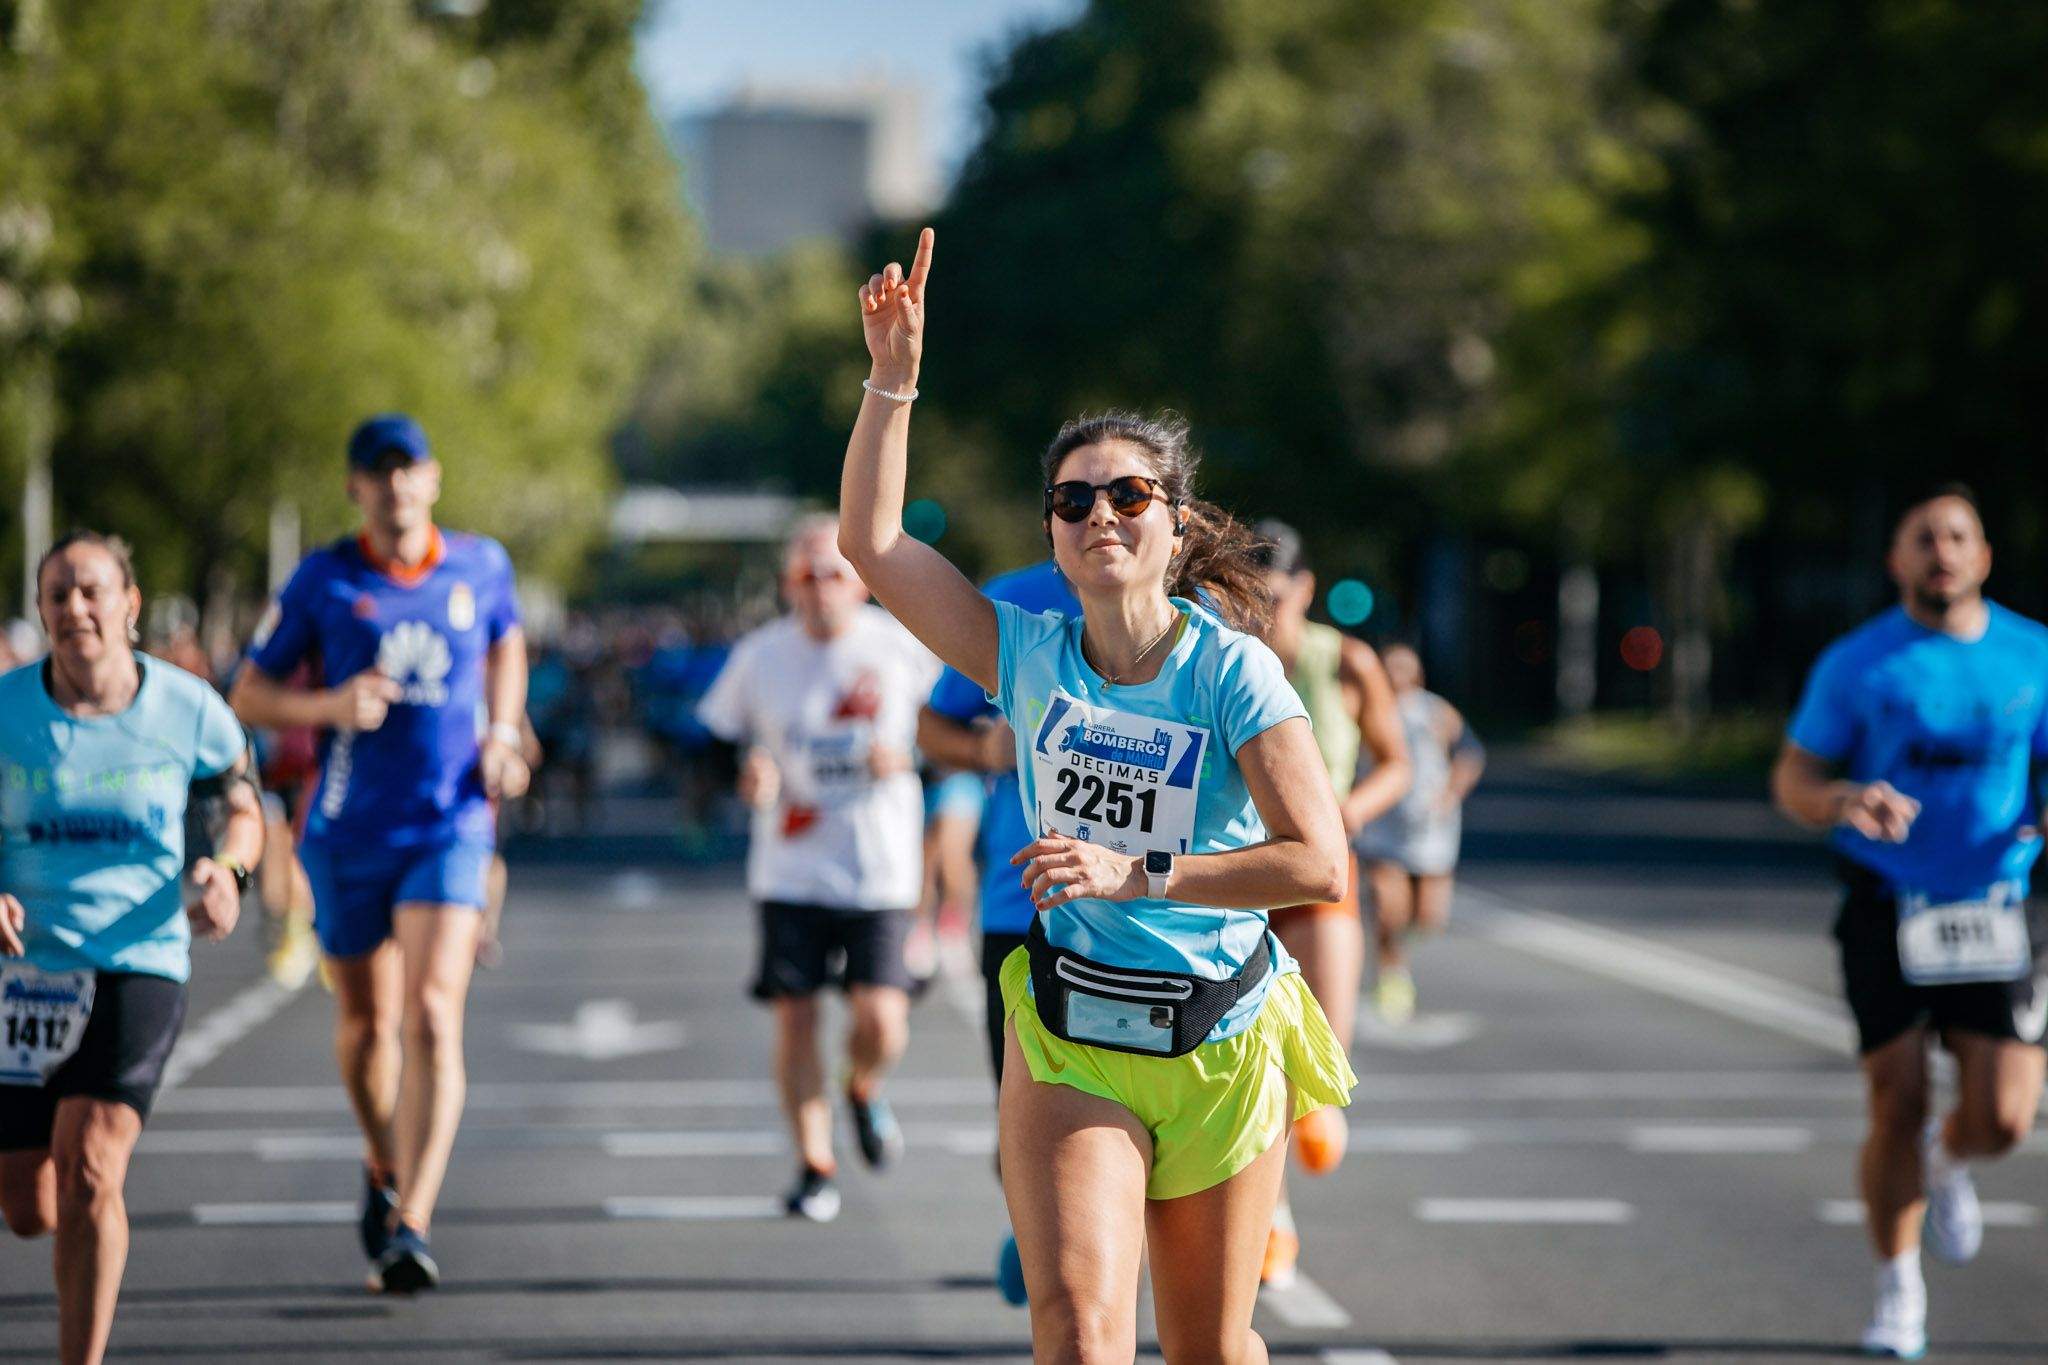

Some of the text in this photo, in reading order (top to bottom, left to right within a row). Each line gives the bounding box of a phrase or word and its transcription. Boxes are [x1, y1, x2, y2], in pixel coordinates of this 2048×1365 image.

[1087, 721, 1116, 734] RRERA
[1083, 729, 1167, 757] BOMBEROS
[1071, 752, 1160, 784] DECIMAS
[1111, 748, 1165, 769] de MADRID
[1054, 767, 1157, 834] 2251
